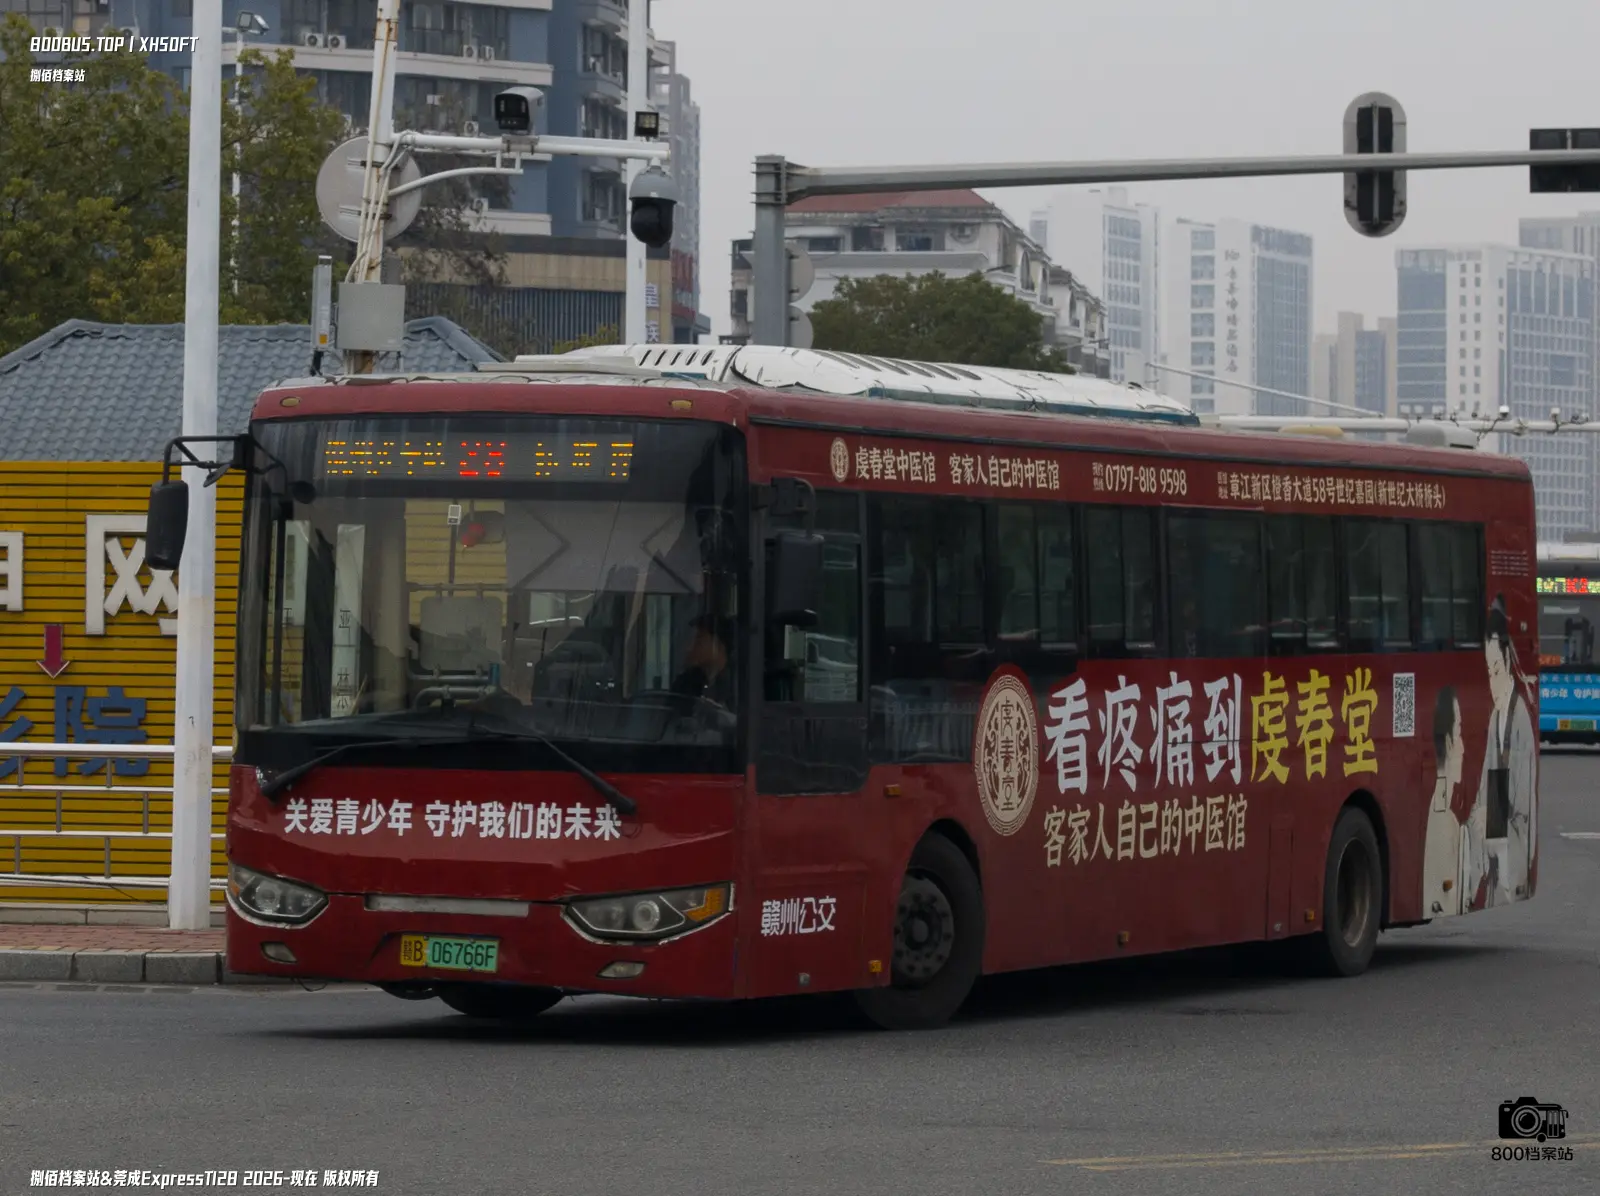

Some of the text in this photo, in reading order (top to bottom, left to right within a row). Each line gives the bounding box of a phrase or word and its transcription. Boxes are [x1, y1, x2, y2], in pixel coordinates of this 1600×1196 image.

[855, 446, 937, 483] 虔春堂中医馆
[949, 453, 1061, 491] 客家人自己的中医馆
[1105, 464, 1188, 497] 0797-818 9598
[284, 797, 622, 841] 关爱青少年 守护我们的未来
[1043, 793, 1249, 868] 客家人自己的中医馆
[761, 895, 837, 937] 赣州公交
